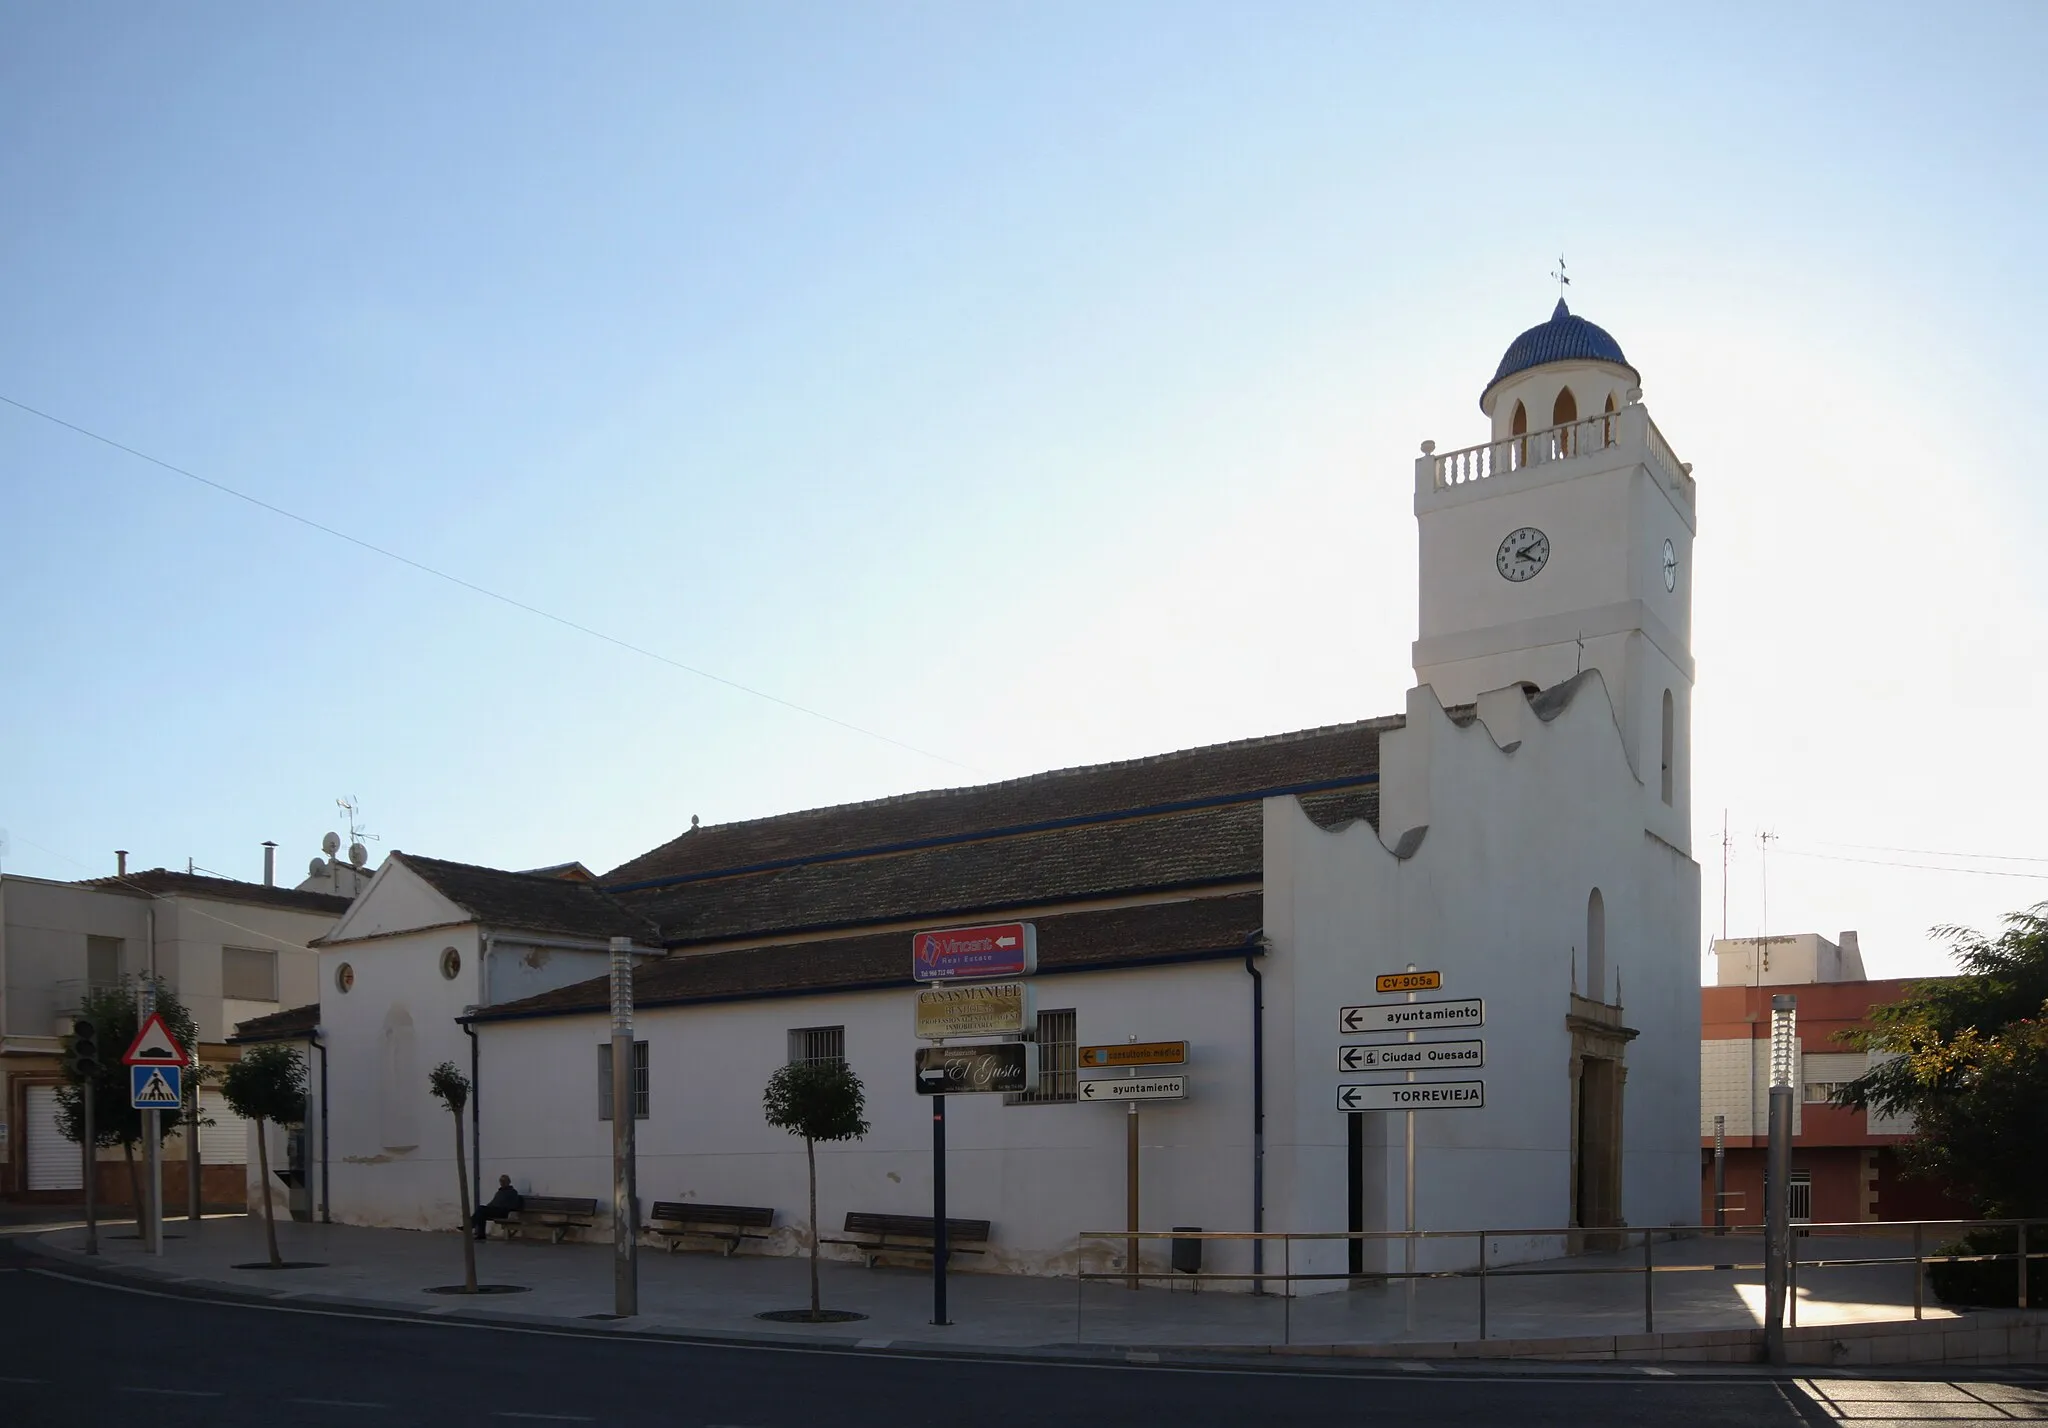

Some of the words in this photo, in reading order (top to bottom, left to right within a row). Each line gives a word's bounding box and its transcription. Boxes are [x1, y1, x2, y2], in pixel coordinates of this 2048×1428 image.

[942, 938, 992, 953] Vincent
[964, 955, 992, 963] Estate
[1383, 976, 1433, 988] CV-905a
[920, 991, 961, 1004] CASAS
[964, 984, 1021, 1000] MANUEL
[1387, 1006, 1478, 1023] ayuntamiento
[946, 1022, 993, 1030] INMOBILIARIA
[1153, 1048, 1181, 1057] médico
[1381, 1052, 1421, 1062] Ciudad
[1427, 1050, 1479, 1061] Quesada
[944, 1058, 972, 1081] El
[973, 1053, 1022, 1085] Gusto
[1113, 1083, 1180, 1095] ayuntamiento
[1392, 1089, 1479, 1102] TORREVIEJA
